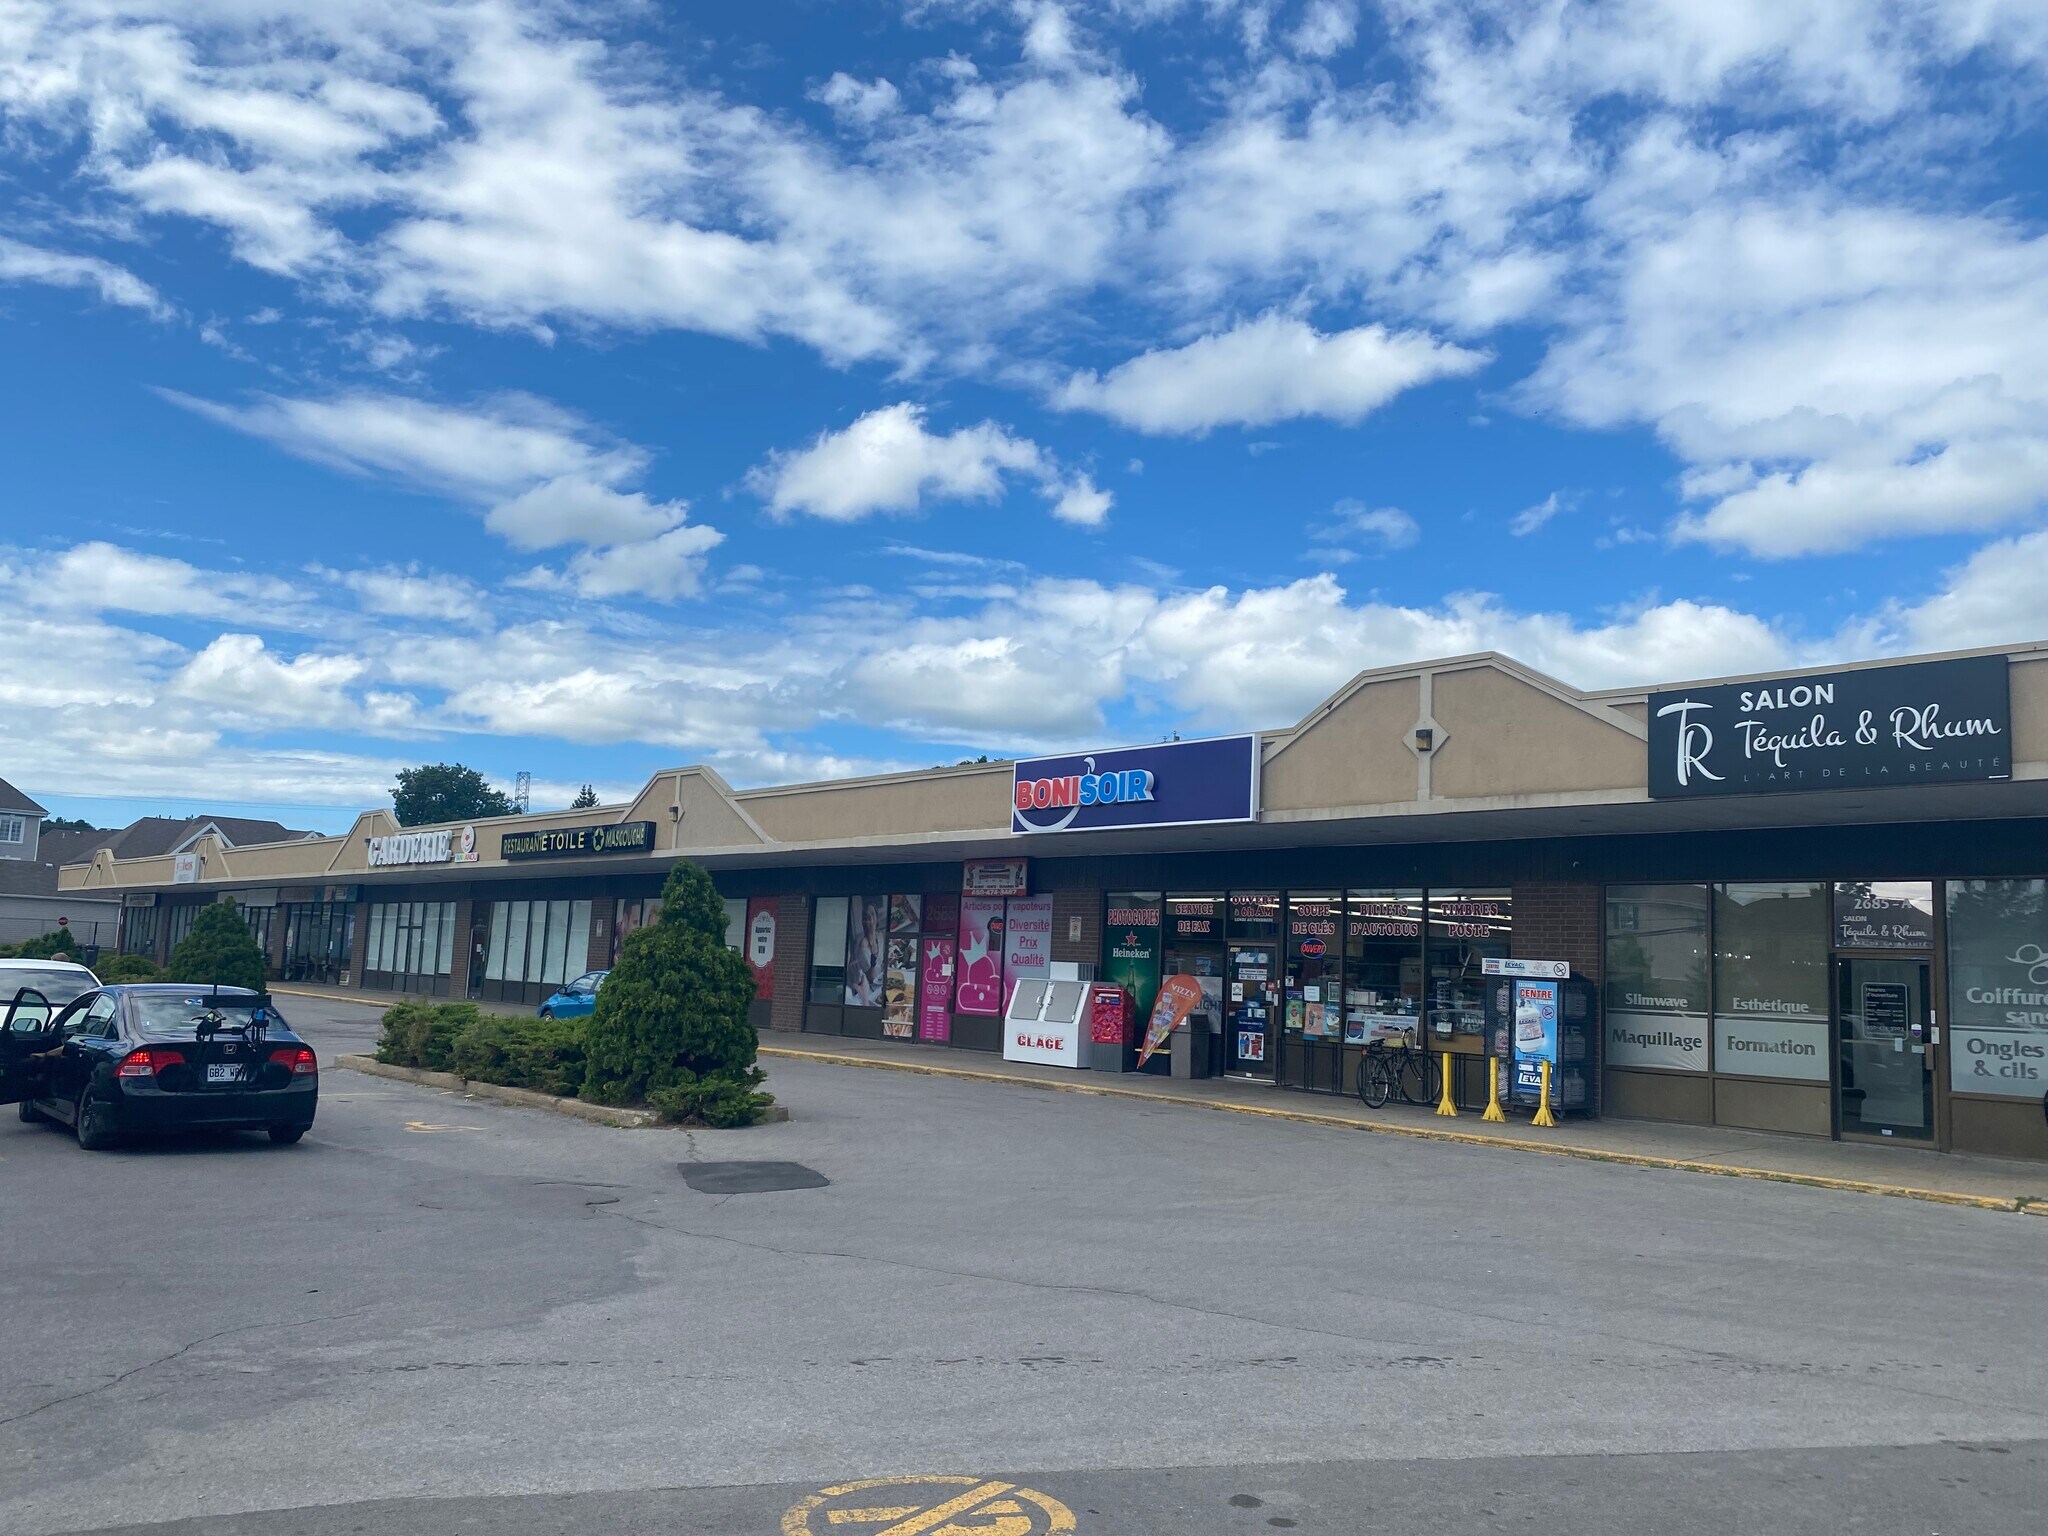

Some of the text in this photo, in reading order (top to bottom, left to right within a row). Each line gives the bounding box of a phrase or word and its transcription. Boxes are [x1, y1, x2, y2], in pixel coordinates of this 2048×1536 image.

[1740, 683, 1834, 712] SALON
[1734, 703, 2002, 768] Téquila & Rhum
[1744, 755, 2000, 782] L'ART DE LA BEAUTÉ
[368, 830, 452, 865] GARDERIE
[503, 827, 645, 855] RESTAURANT ÉTOILE MASCOUCHE
[963, 901, 1051, 912] Articles por vapoteurs
[1232, 895, 1277, 905] OUVERT
[1175, 903, 1213, 915] SERVICE
[1254, 908, 1274, 917] AM
[1297, 904, 1331, 916] COUPE
[1360, 904, 1408, 917] BILLETS
[1441, 903, 1498, 917] TIMBRES
[1009, 918, 1050, 930] Diversité
[1107, 909, 1159, 926] PHOTOCOPIES
[1178, 920, 1210, 933] DE FAX
[1292, 919, 1335, 935] DE CLÉS
[1351, 923, 1418, 937] D'AUTOBUS
[1449, 923, 1490, 938] POSTE
[1840, 924, 1927, 941] Téquila & Rhum
[1019, 935, 1038, 948] Prix
[1301, 942, 1326, 953] OUVERT
[1011, 952, 1045, 965] Qualité
[1112, 947, 1150, 959] Heineken
[1171, 983, 1197, 998] VIZZY
[1519, 988, 1553, 999] CENTRE
[1625, 993, 1688, 1008] Slimwave
[1732, 997, 1809, 1015] Esthétique
[1612, 1028, 1703, 1052] Maquillage
[1727, 1035, 1816, 1056] Formation
[1966, 1038, 2045, 1061] Ongles
[1973, 1059, 2039, 1080] & cils
